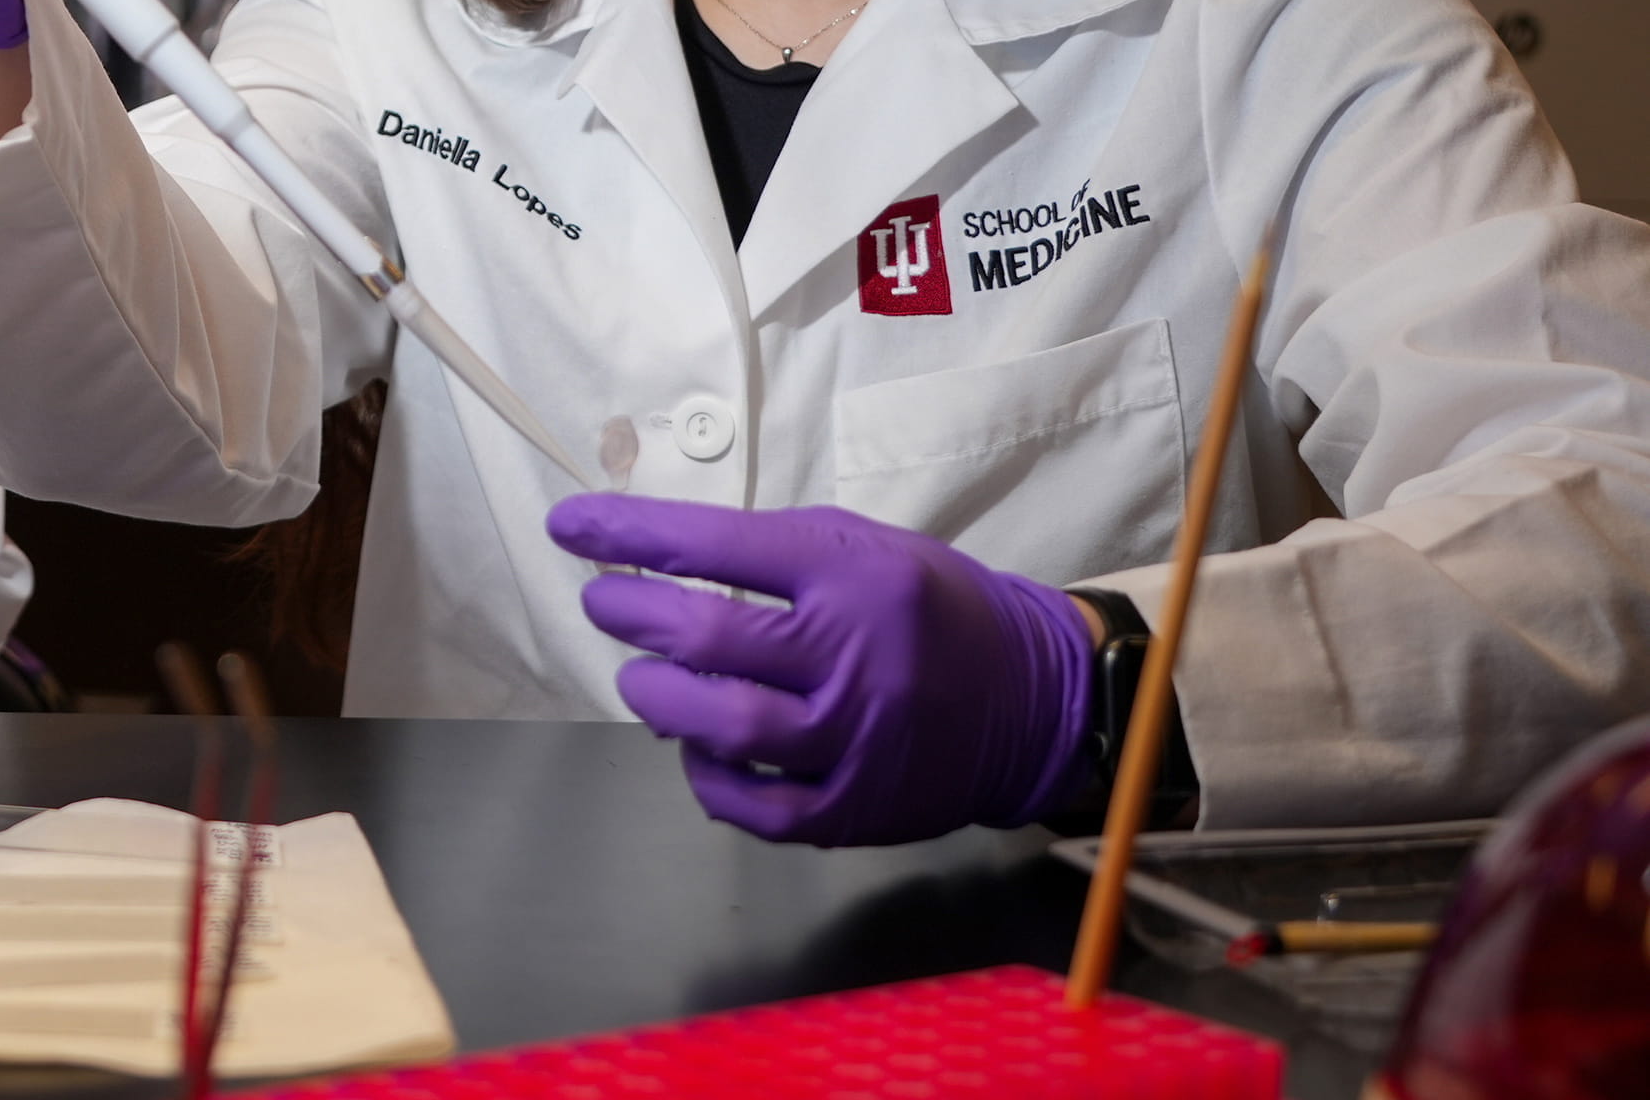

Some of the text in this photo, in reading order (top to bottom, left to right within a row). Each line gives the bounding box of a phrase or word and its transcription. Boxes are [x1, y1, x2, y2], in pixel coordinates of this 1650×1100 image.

[376, 109, 583, 241] Daniella Lopes
[963, 201, 1067, 239] SCHOOL
[968, 184, 1151, 293] MEDICINE
